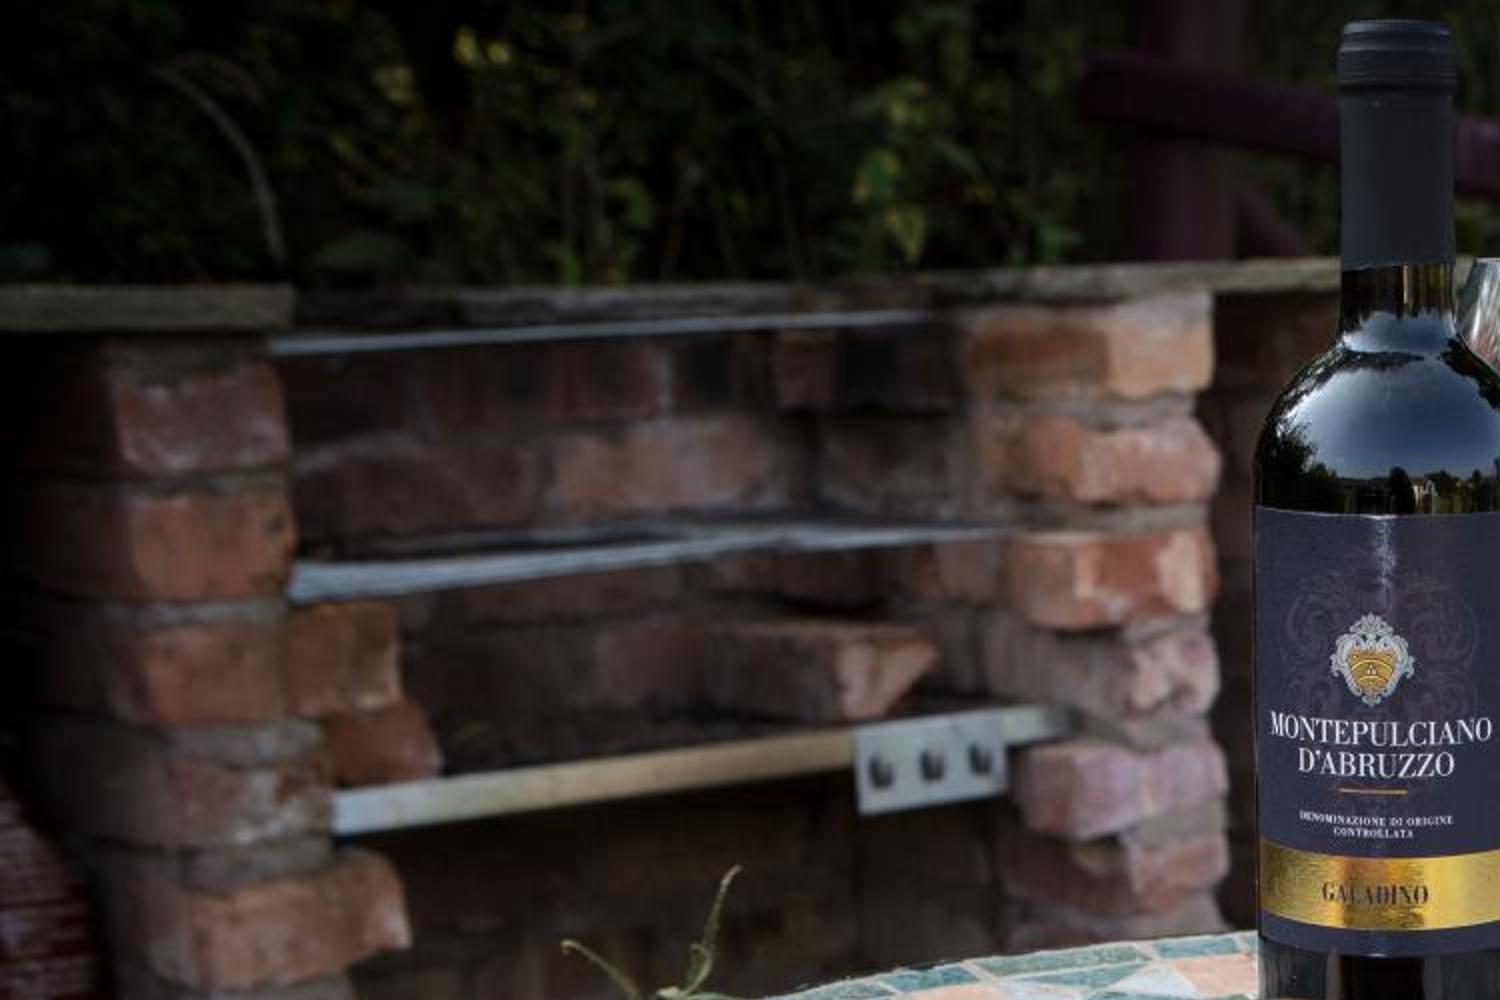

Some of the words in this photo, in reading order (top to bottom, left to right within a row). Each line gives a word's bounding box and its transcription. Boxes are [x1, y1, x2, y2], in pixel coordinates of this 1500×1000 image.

[1271, 711, 1493, 747] MONTEPULCIANO
[1298, 747, 1455, 778] D'ABRUZZO
[1299, 810, 1386, 827] DENOMINAZIONE
[1390, 817, 1403, 827] DI
[1406, 815, 1454, 827] ORIGINE
[1333, 826, 1413, 839] CONTROLLATA
